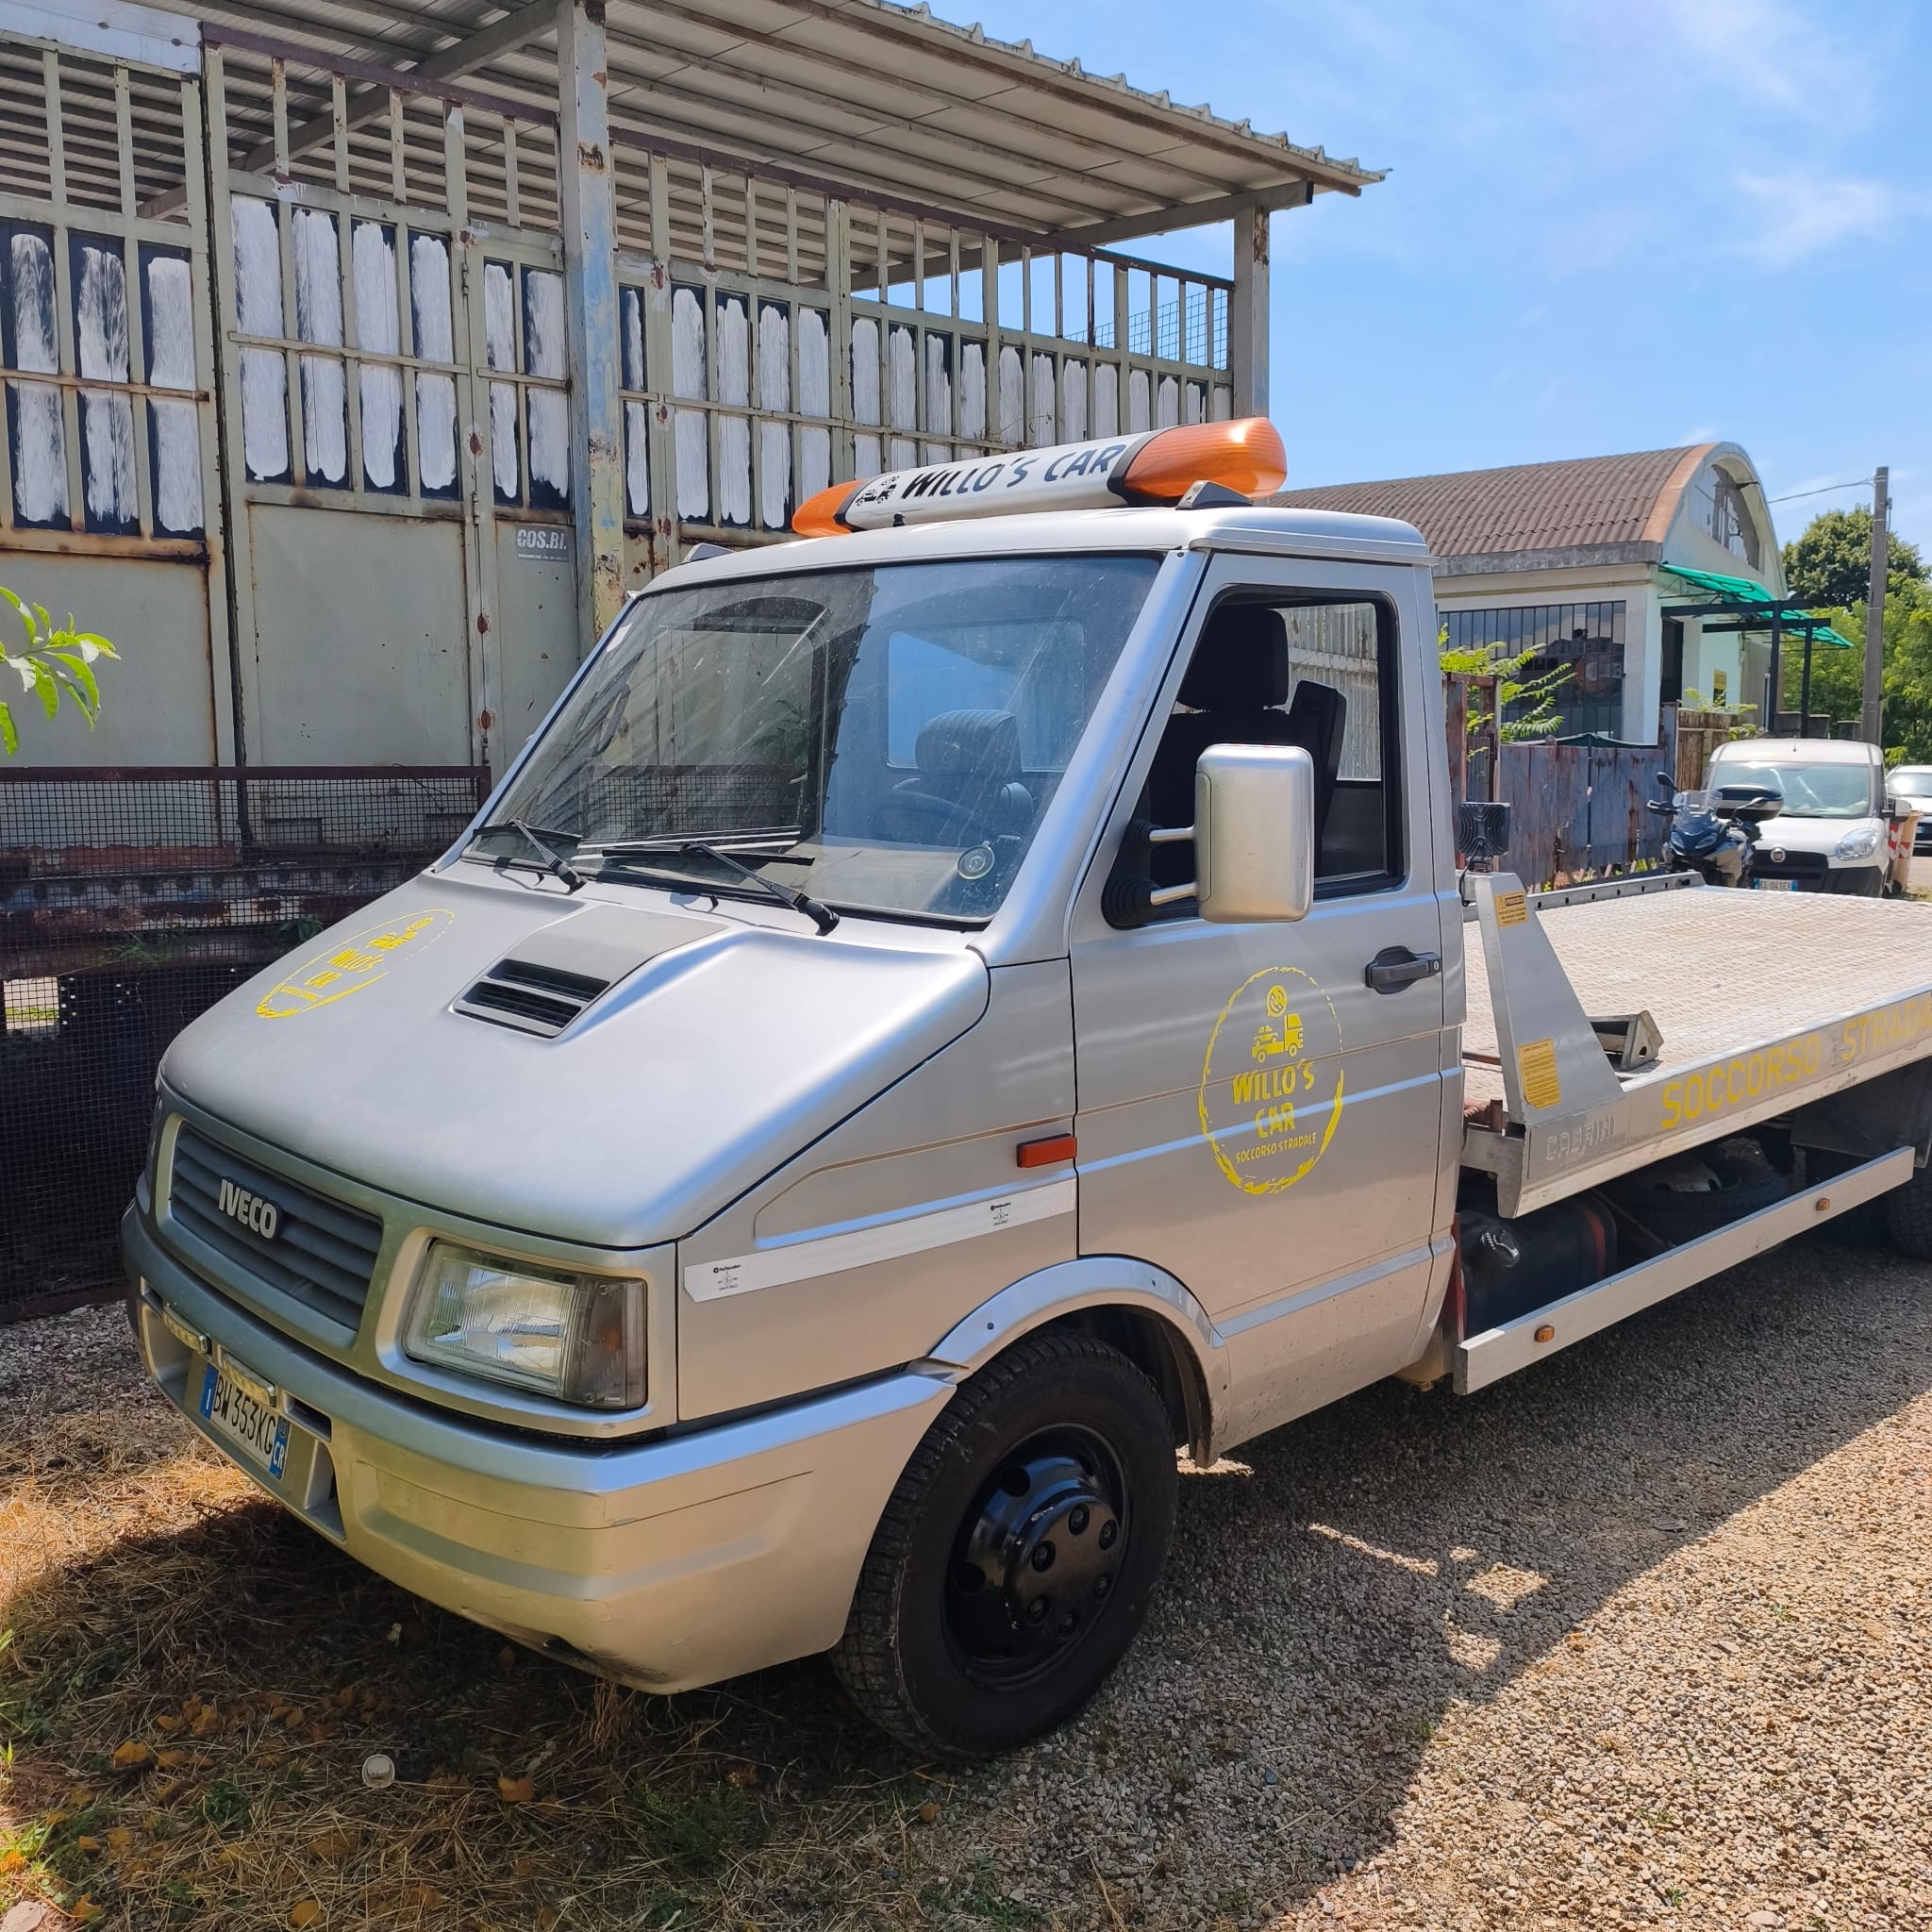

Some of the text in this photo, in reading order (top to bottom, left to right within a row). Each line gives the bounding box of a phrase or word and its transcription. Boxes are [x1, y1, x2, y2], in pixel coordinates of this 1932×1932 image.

[901, 443, 1126, 500] WILLO'S CAR
[1232, 1058, 1315, 1106] WILLO'S
[1661, 1035, 1821, 1129] SOCCORSO
[1255, 1102, 1296, 1139] CAR
[1235, 1132, 1317, 1163] SOCCORSO STRADALE
[218, 1178, 277, 1239] IVECO
